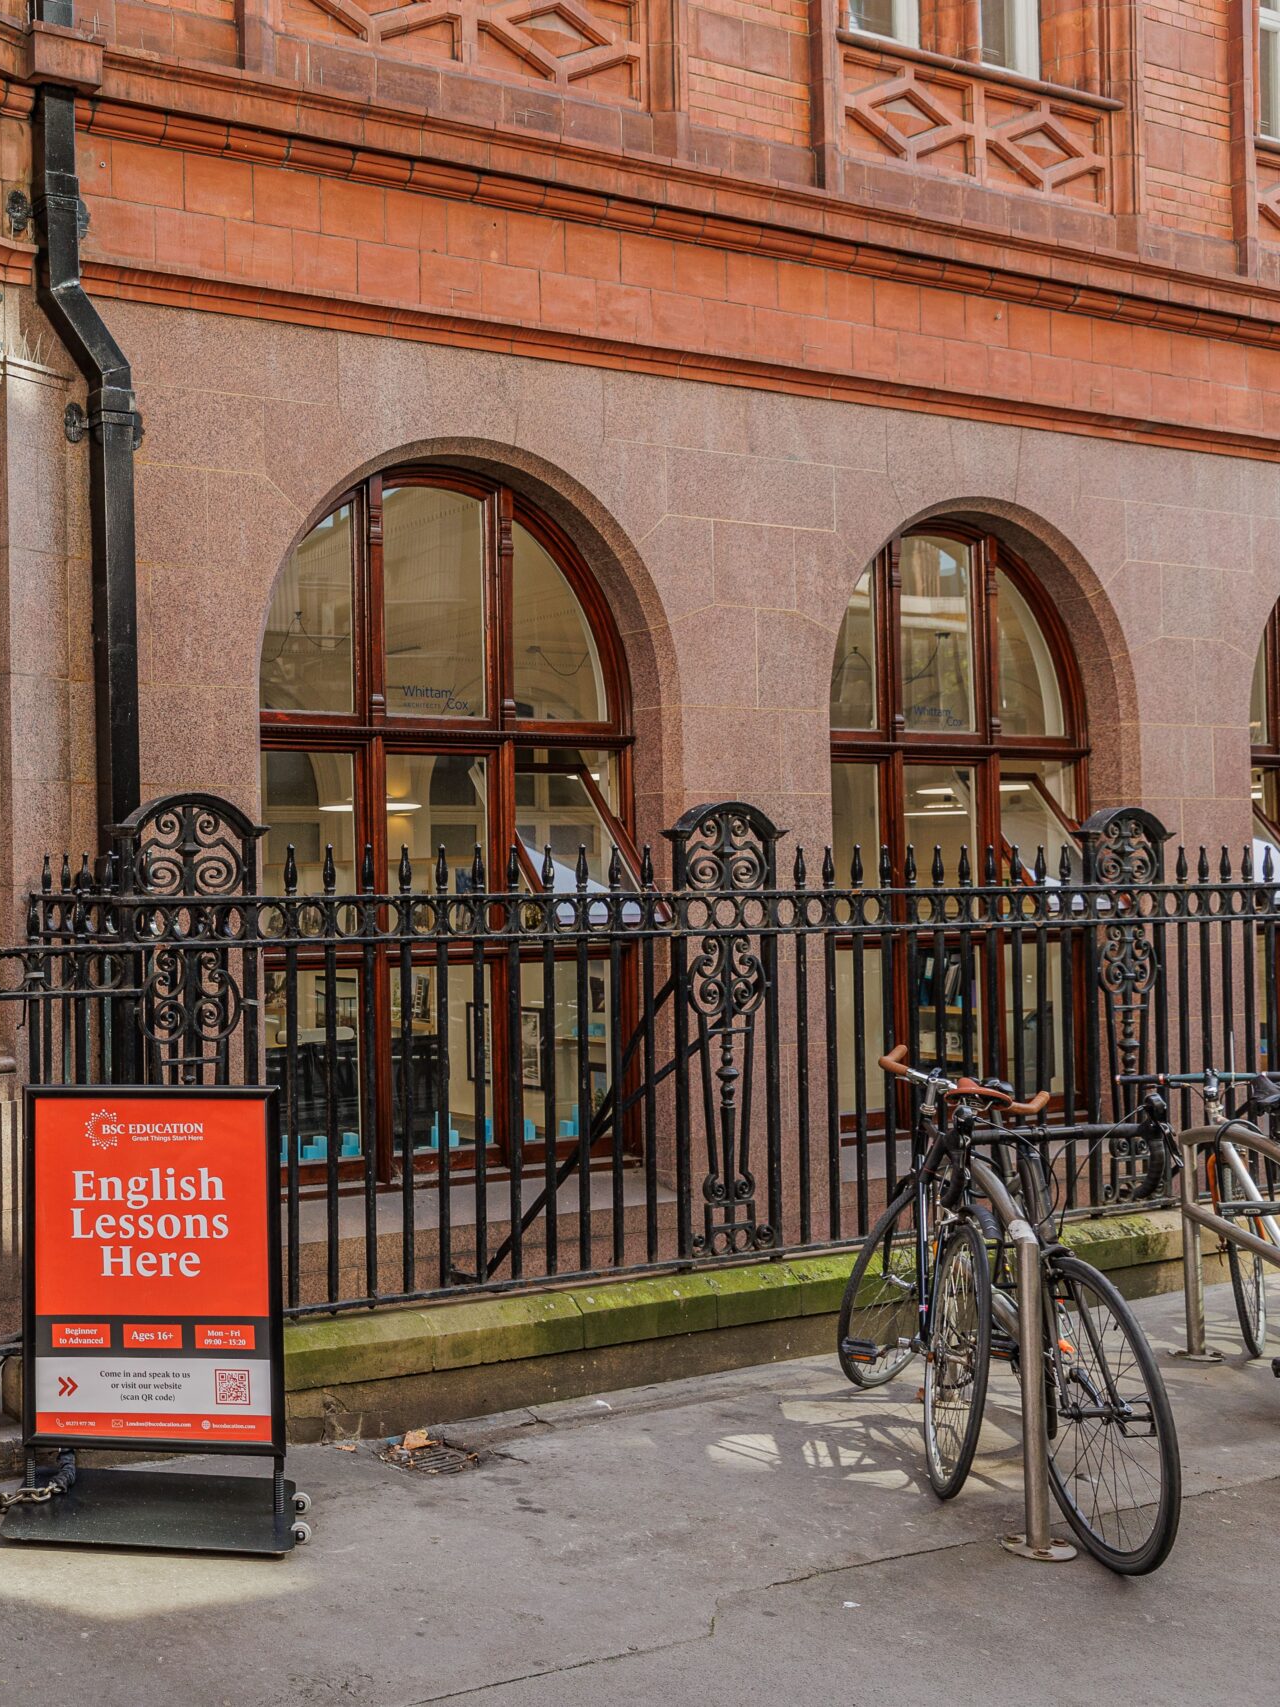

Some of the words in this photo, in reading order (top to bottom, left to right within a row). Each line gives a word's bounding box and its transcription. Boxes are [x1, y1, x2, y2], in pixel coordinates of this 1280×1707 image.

[402, 685, 452, 698] Whittam
[447, 698, 468, 710] Cox
[102, 1124, 125, 1134] BSC
[128, 1123, 204, 1134] EDUCATION
[72, 1167, 226, 1209] English
[70, 1207, 230, 1239] Lessons
[100, 1245, 201, 1278] Here
[65, 1327, 97, 1335] Beginner
[131, 1330, 155, 1342] Ages
[157, 1331, 173, 1340] 16+
[99, 1370, 122, 1378] Come
[123, 1369, 131, 1378] in
[132, 1370, 147, 1378] and
[148, 1370, 171, 1379] speak
[121, 1381, 136, 1389] visit
[153, 1382, 182, 1390] website
[120, 1393, 140, 1401] (scan
[141, 1393, 153, 1402] QR
[155, 1393, 176, 1402] code)
